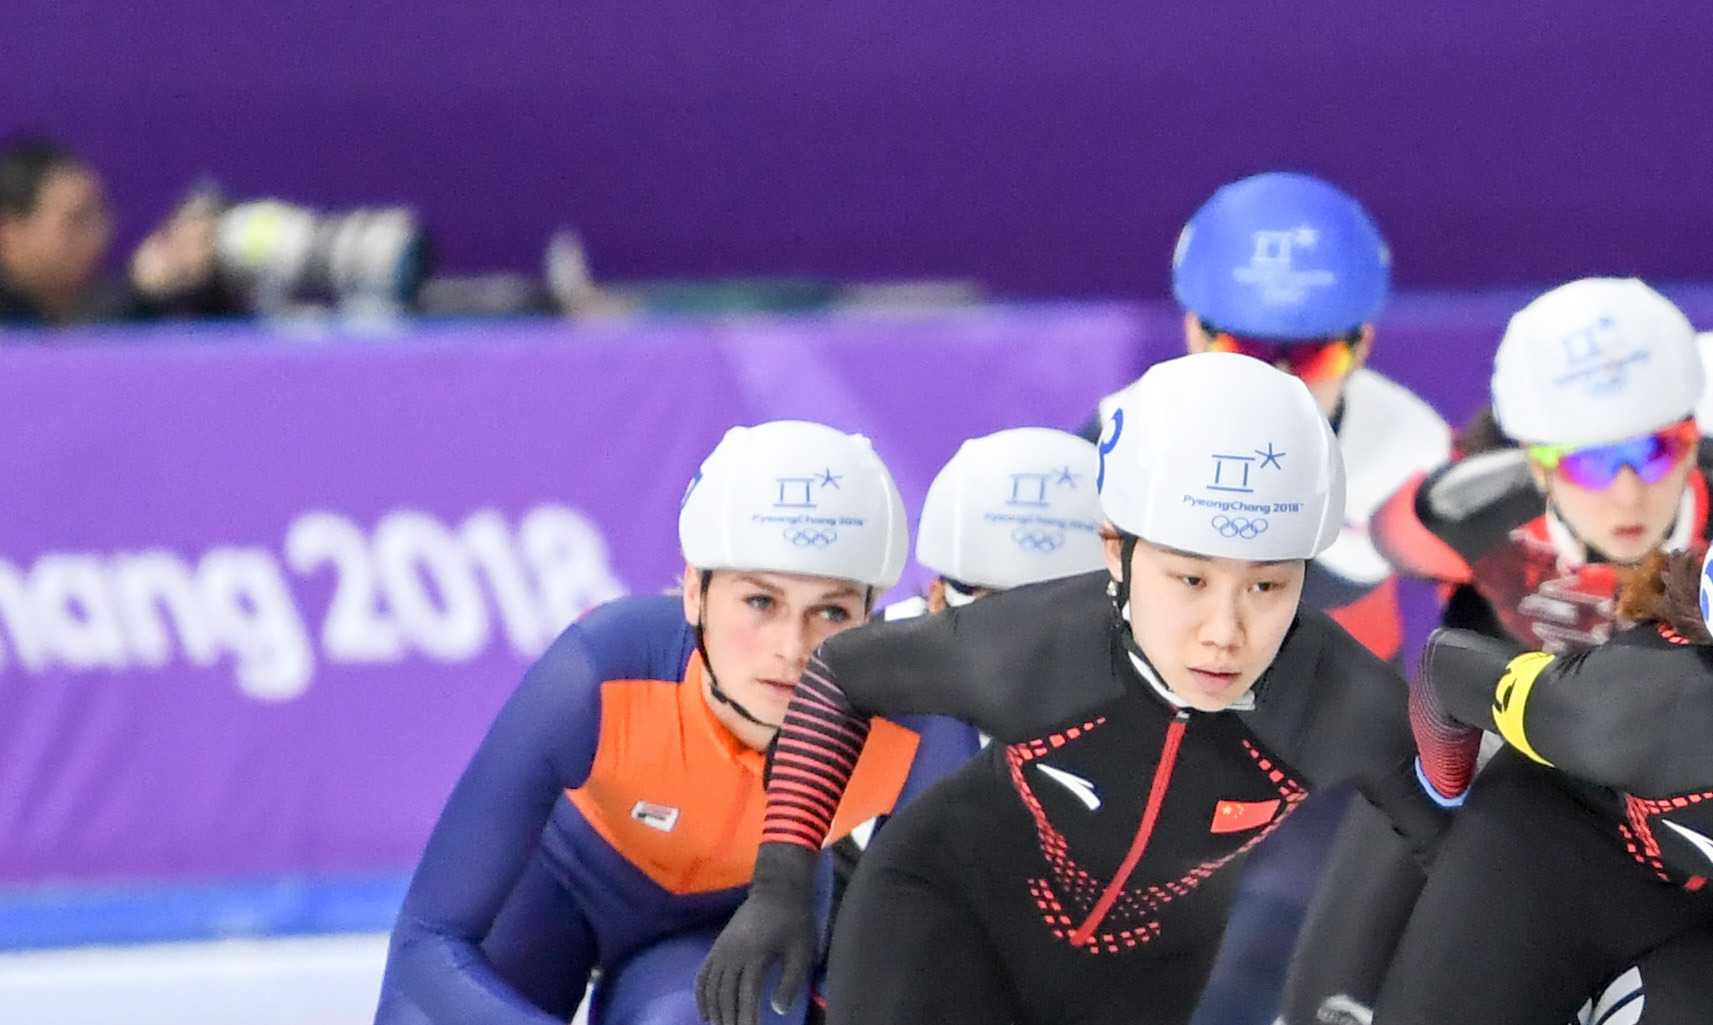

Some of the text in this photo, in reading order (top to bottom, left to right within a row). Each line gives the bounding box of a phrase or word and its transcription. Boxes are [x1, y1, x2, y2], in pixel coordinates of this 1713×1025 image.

[1183, 494, 1299, 515] PyeongChang 2018
[286, 503, 628, 664] 2018
